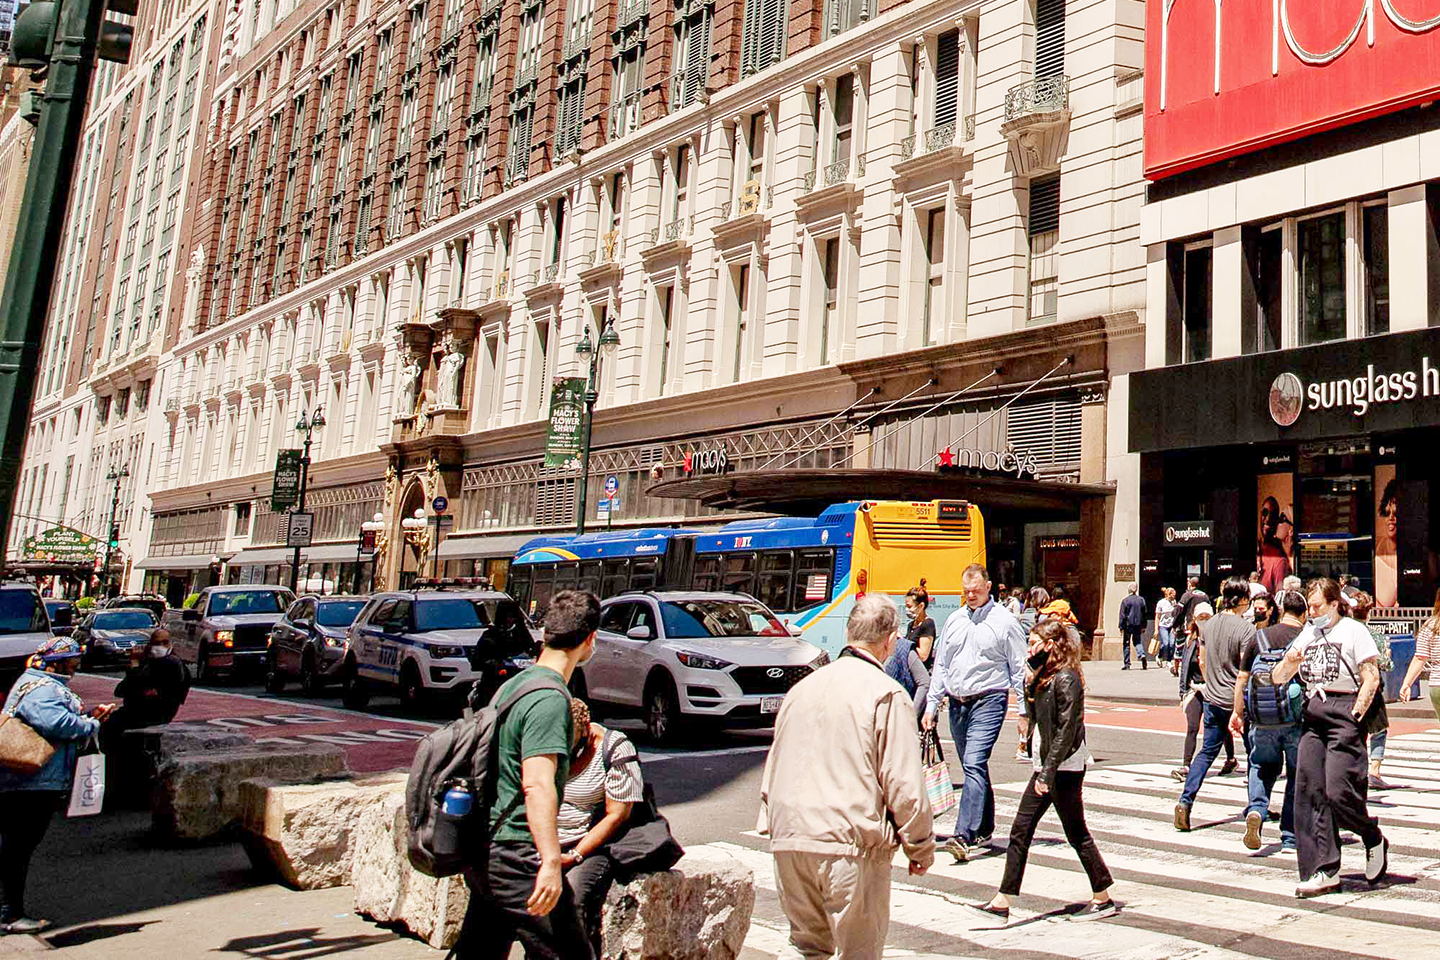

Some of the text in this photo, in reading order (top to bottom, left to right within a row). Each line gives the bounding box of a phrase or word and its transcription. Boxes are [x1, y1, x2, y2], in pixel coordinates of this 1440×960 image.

[1307, 364, 1417, 416] sunglass
[551, 417, 580, 426] FLOWER
[292, 527, 309, 536] 25
[1175, 526, 1210, 541] sunglass hut
[1040, 539, 1055, 547] LOUIS
[1367, 622, 1409, 634] way-PATH
[80, 765, 100, 807] rack
